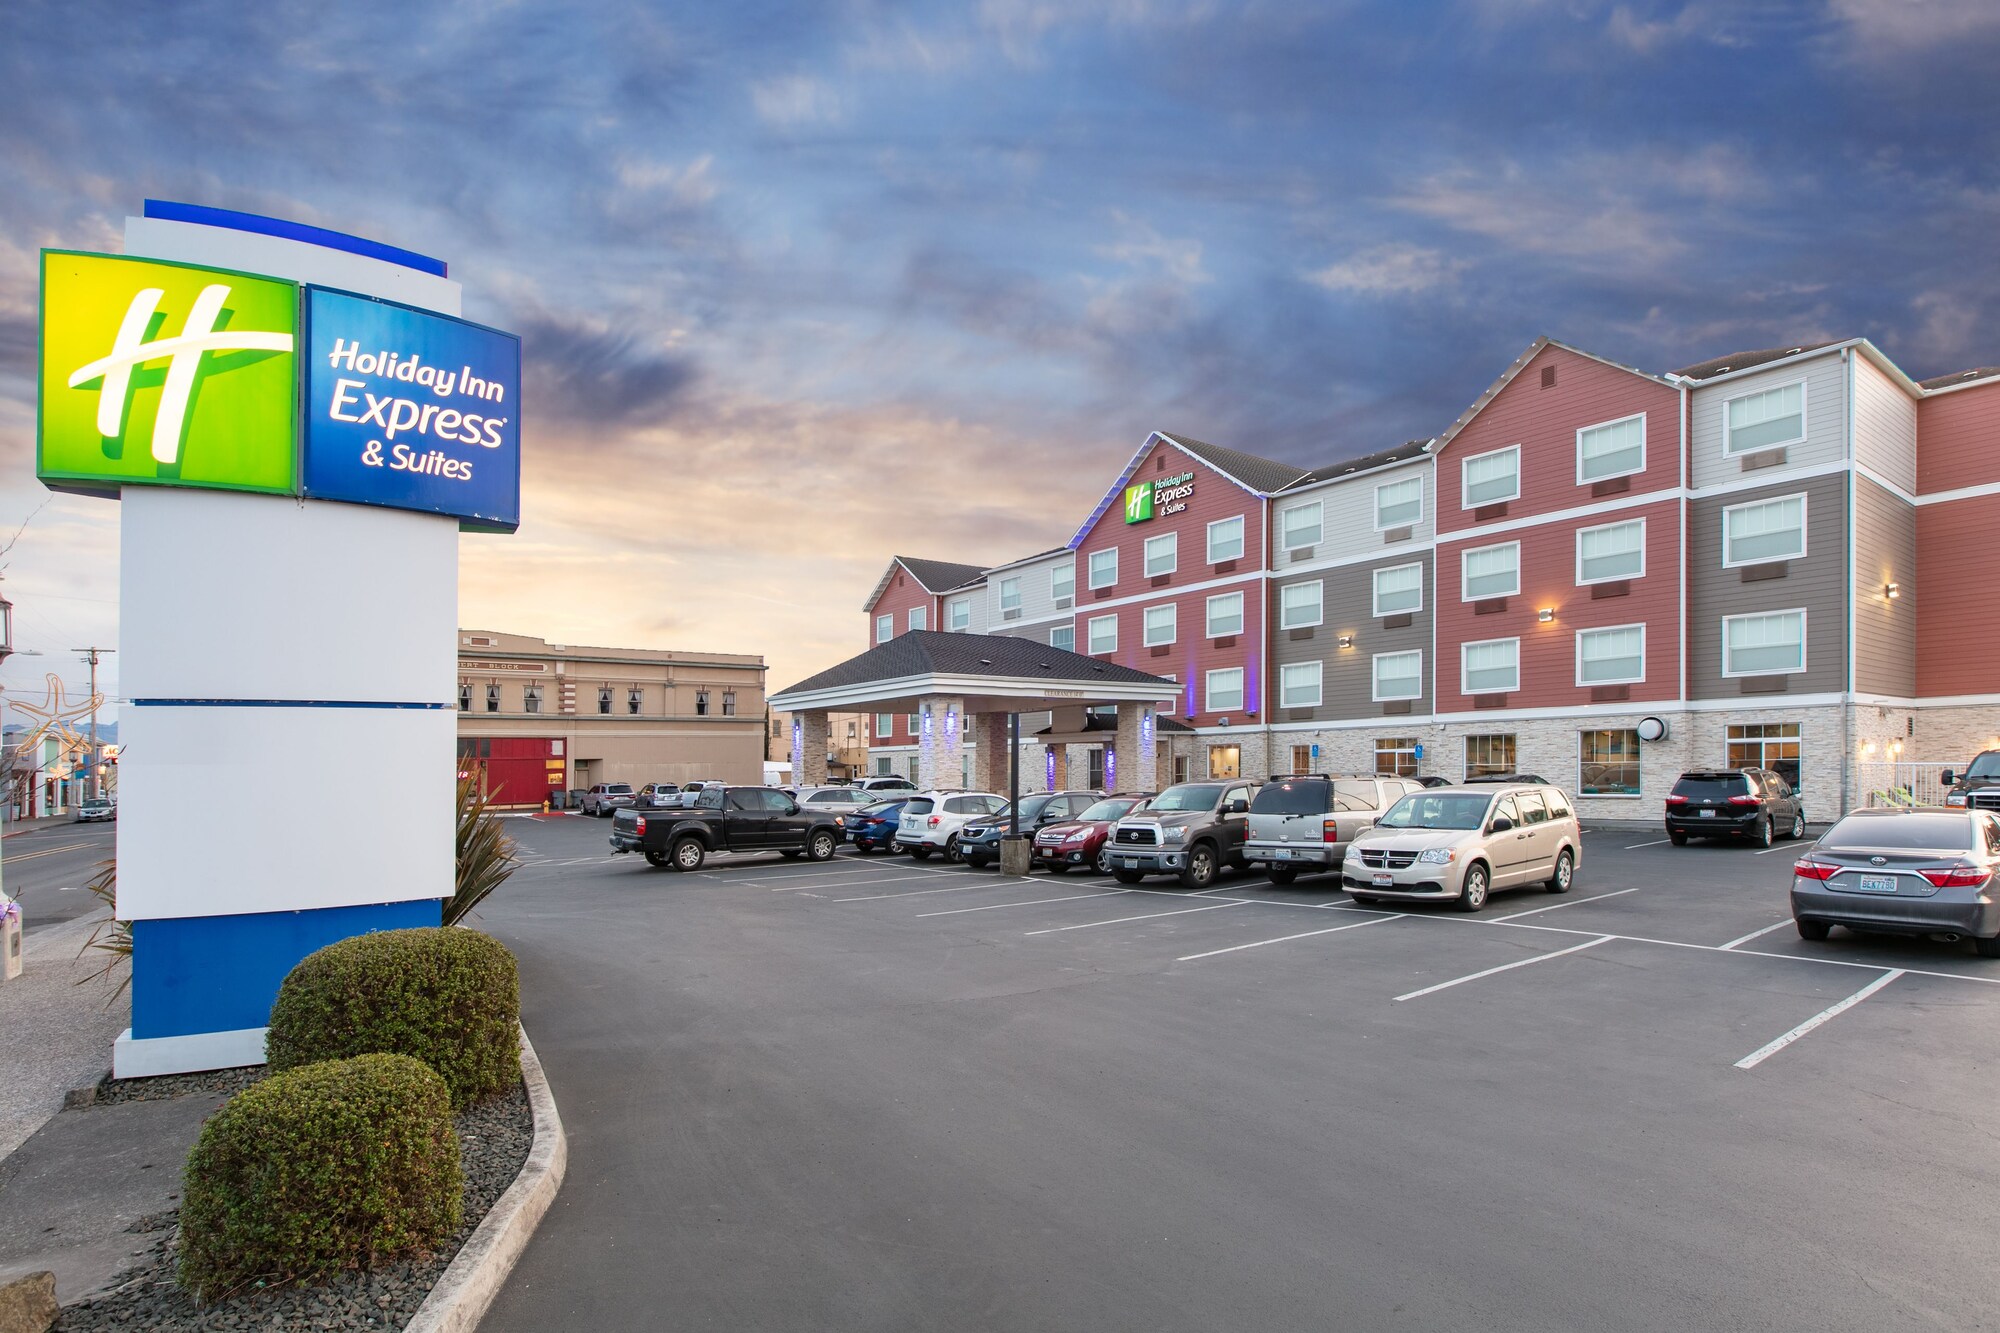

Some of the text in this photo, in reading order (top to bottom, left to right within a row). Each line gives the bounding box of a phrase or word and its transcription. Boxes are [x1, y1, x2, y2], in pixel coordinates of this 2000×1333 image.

[329, 338, 504, 403] Holiday Inn
[329, 378, 505, 448] Express
[361, 440, 473, 481] & Suites
[1154, 471, 1193, 490] Holiday Inn
[1154, 483, 1193, 505] Express
[1160, 502, 1186, 516] & Suites
